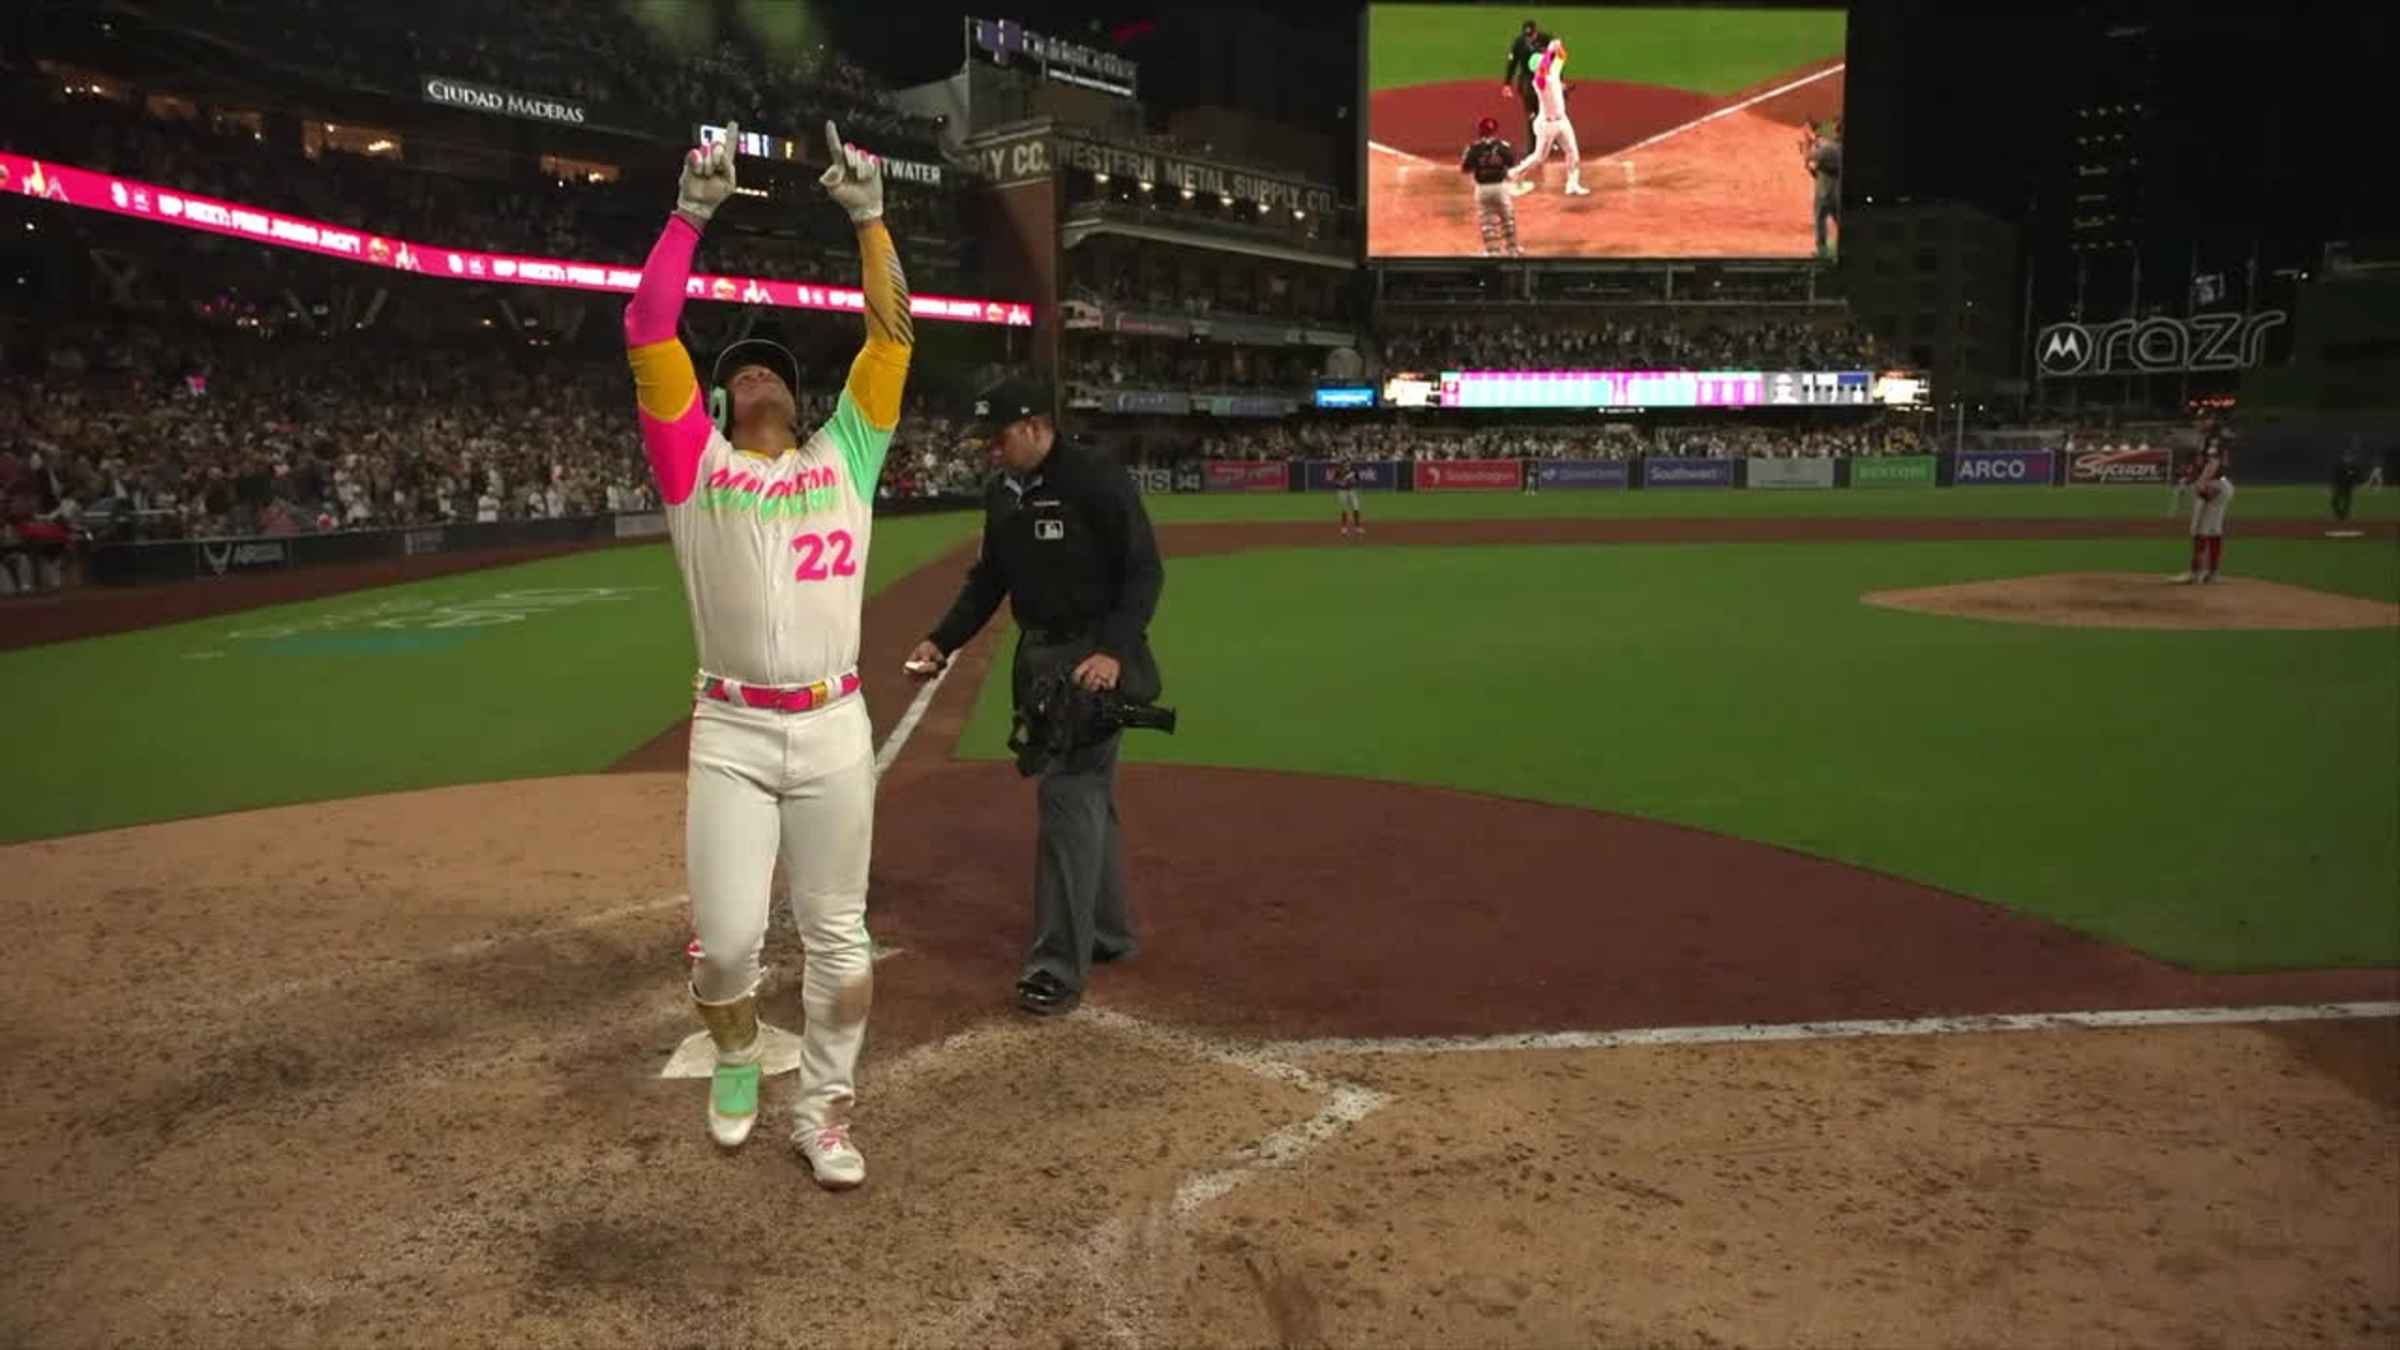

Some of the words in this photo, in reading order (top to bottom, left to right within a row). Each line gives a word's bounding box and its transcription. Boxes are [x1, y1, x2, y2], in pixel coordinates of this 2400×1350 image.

[427, 79, 504, 110] CIUDAD
[507, 92, 585, 123] MADERAS
[881, 156, 942, 185] TWATER
[1056, 141, 1156, 182] WESTERN
[1164, 160, 1229, 197] METAL
[1232, 174, 1302, 210] SUPPLY
[2095, 309, 2288, 375] razr
[1959, 459, 2026, 480] ARCO
[792, 530, 857, 582] 22
